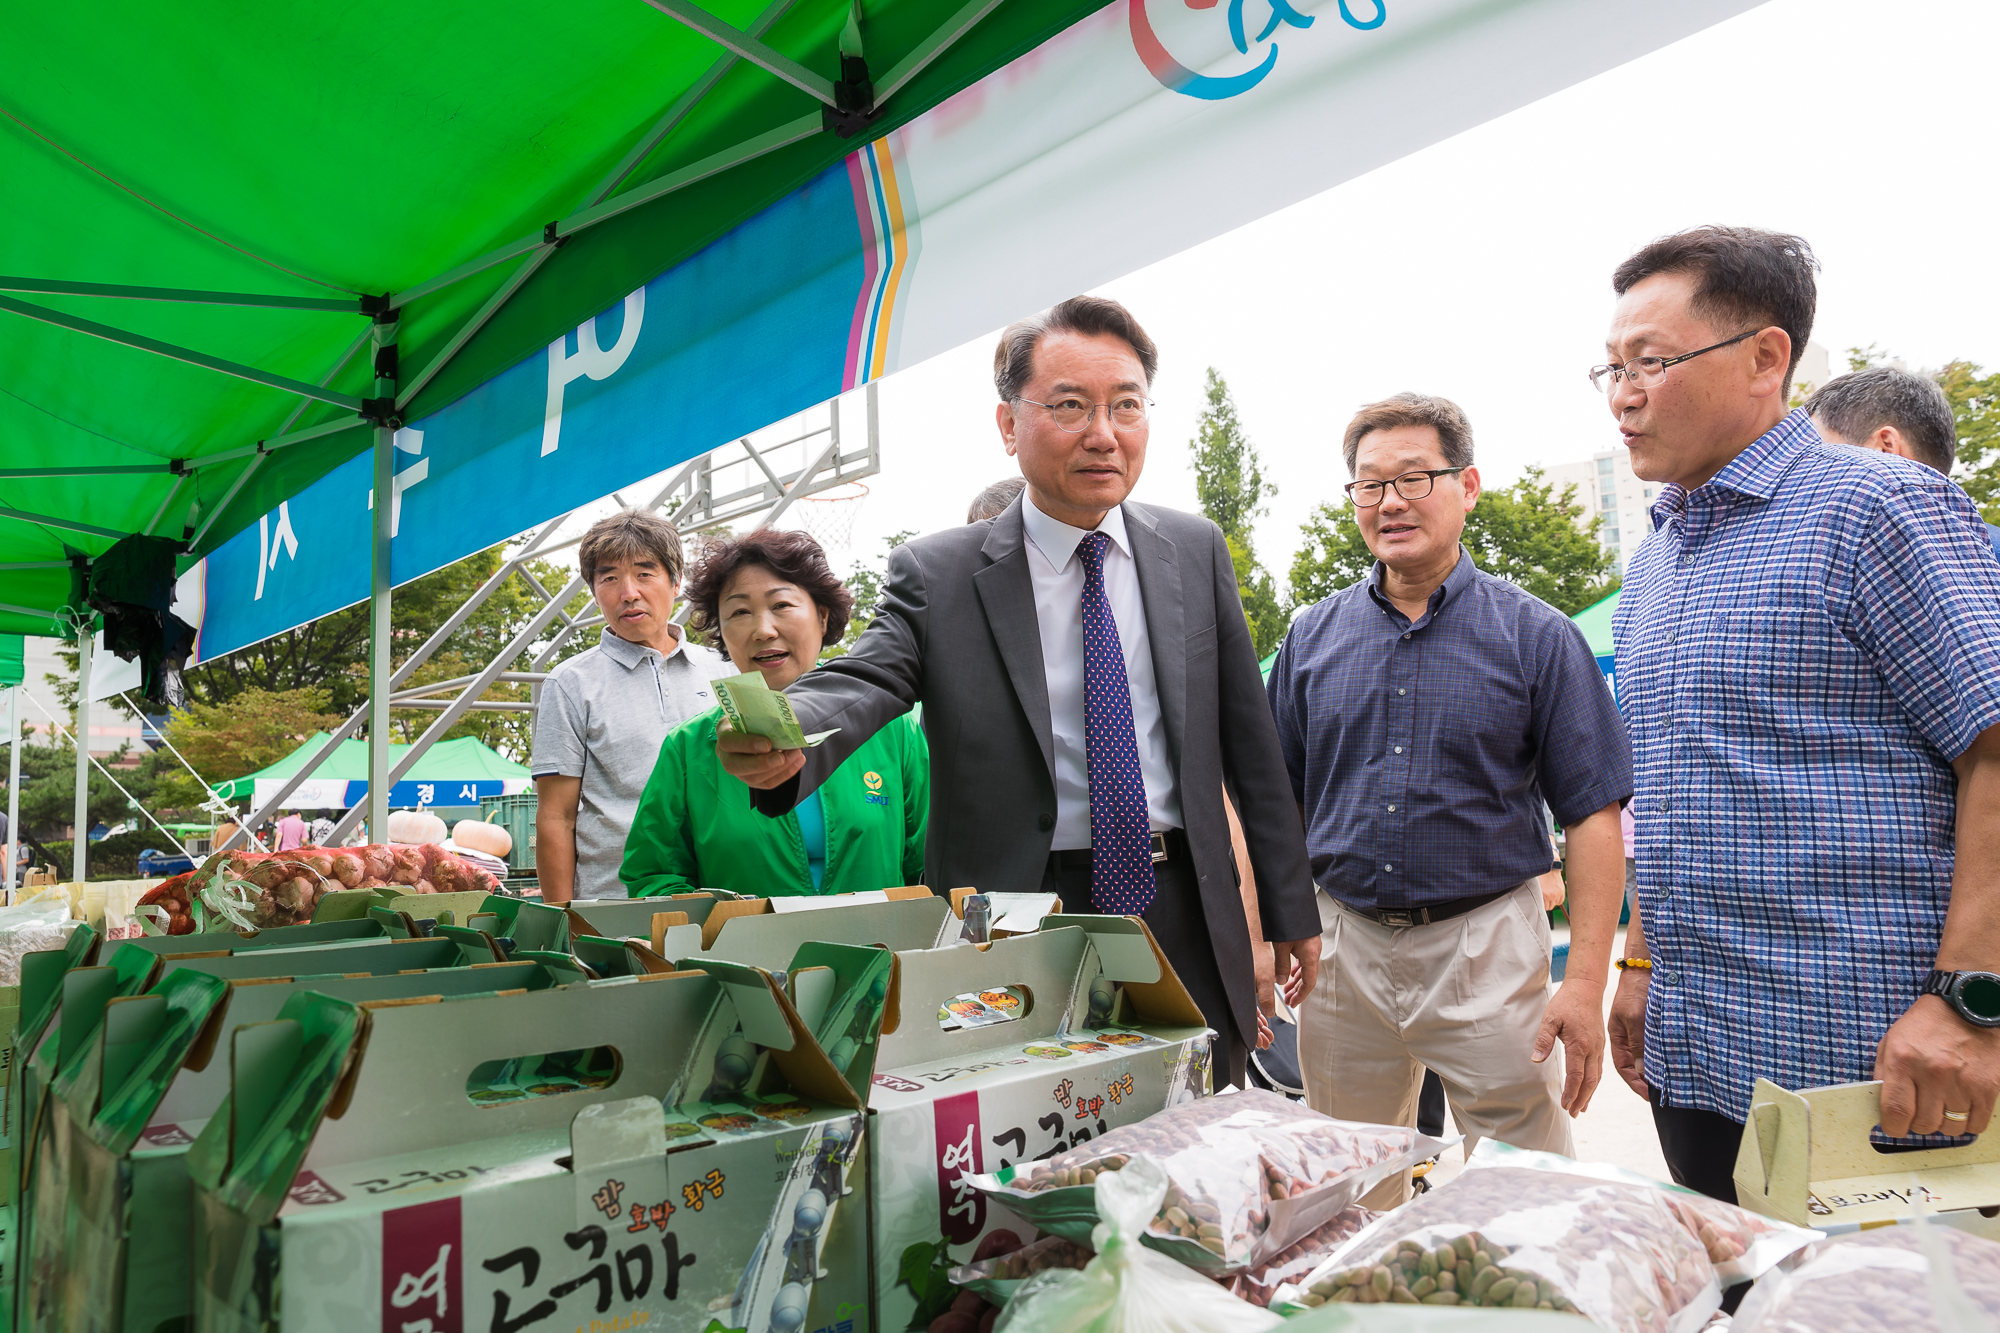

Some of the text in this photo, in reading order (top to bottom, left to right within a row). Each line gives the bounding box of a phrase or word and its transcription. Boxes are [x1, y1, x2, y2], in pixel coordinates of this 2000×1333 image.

[915, 1060, 1006, 1082] 고구마
[1053, 1072, 1135, 1120] 밤 호박 황금
[352, 1165, 495, 1194] 고구마
[591, 1167, 727, 1234] 밤 호박 황금
[481, 1224, 697, 1333] 고구마
